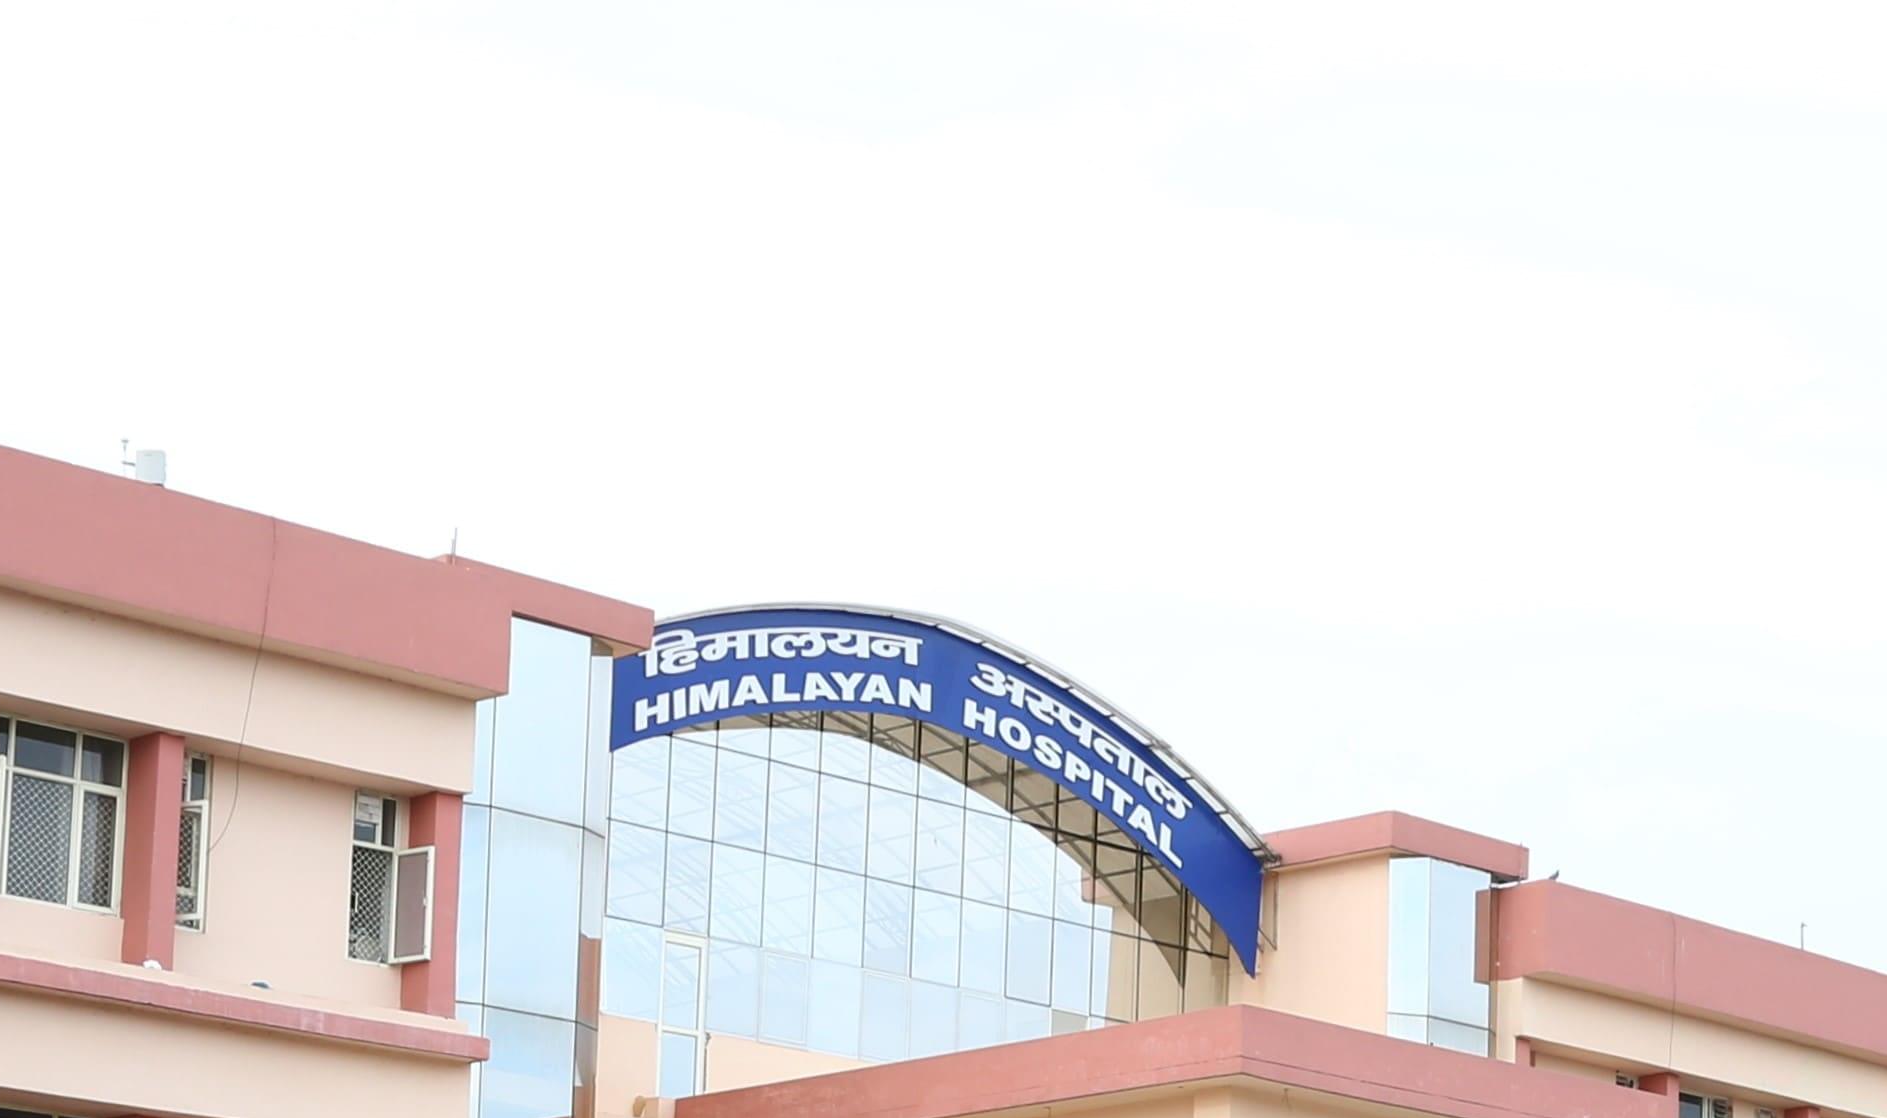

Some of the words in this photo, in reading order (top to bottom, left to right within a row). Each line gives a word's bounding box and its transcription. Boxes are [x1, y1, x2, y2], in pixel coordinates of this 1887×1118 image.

[634, 672, 932, 732] HIMALAYAN
[963, 698, 1183, 869] HOSPITAL
[638, 626, 923, 678] हिमालयन
[969, 662, 1193, 820] अस्पताल
